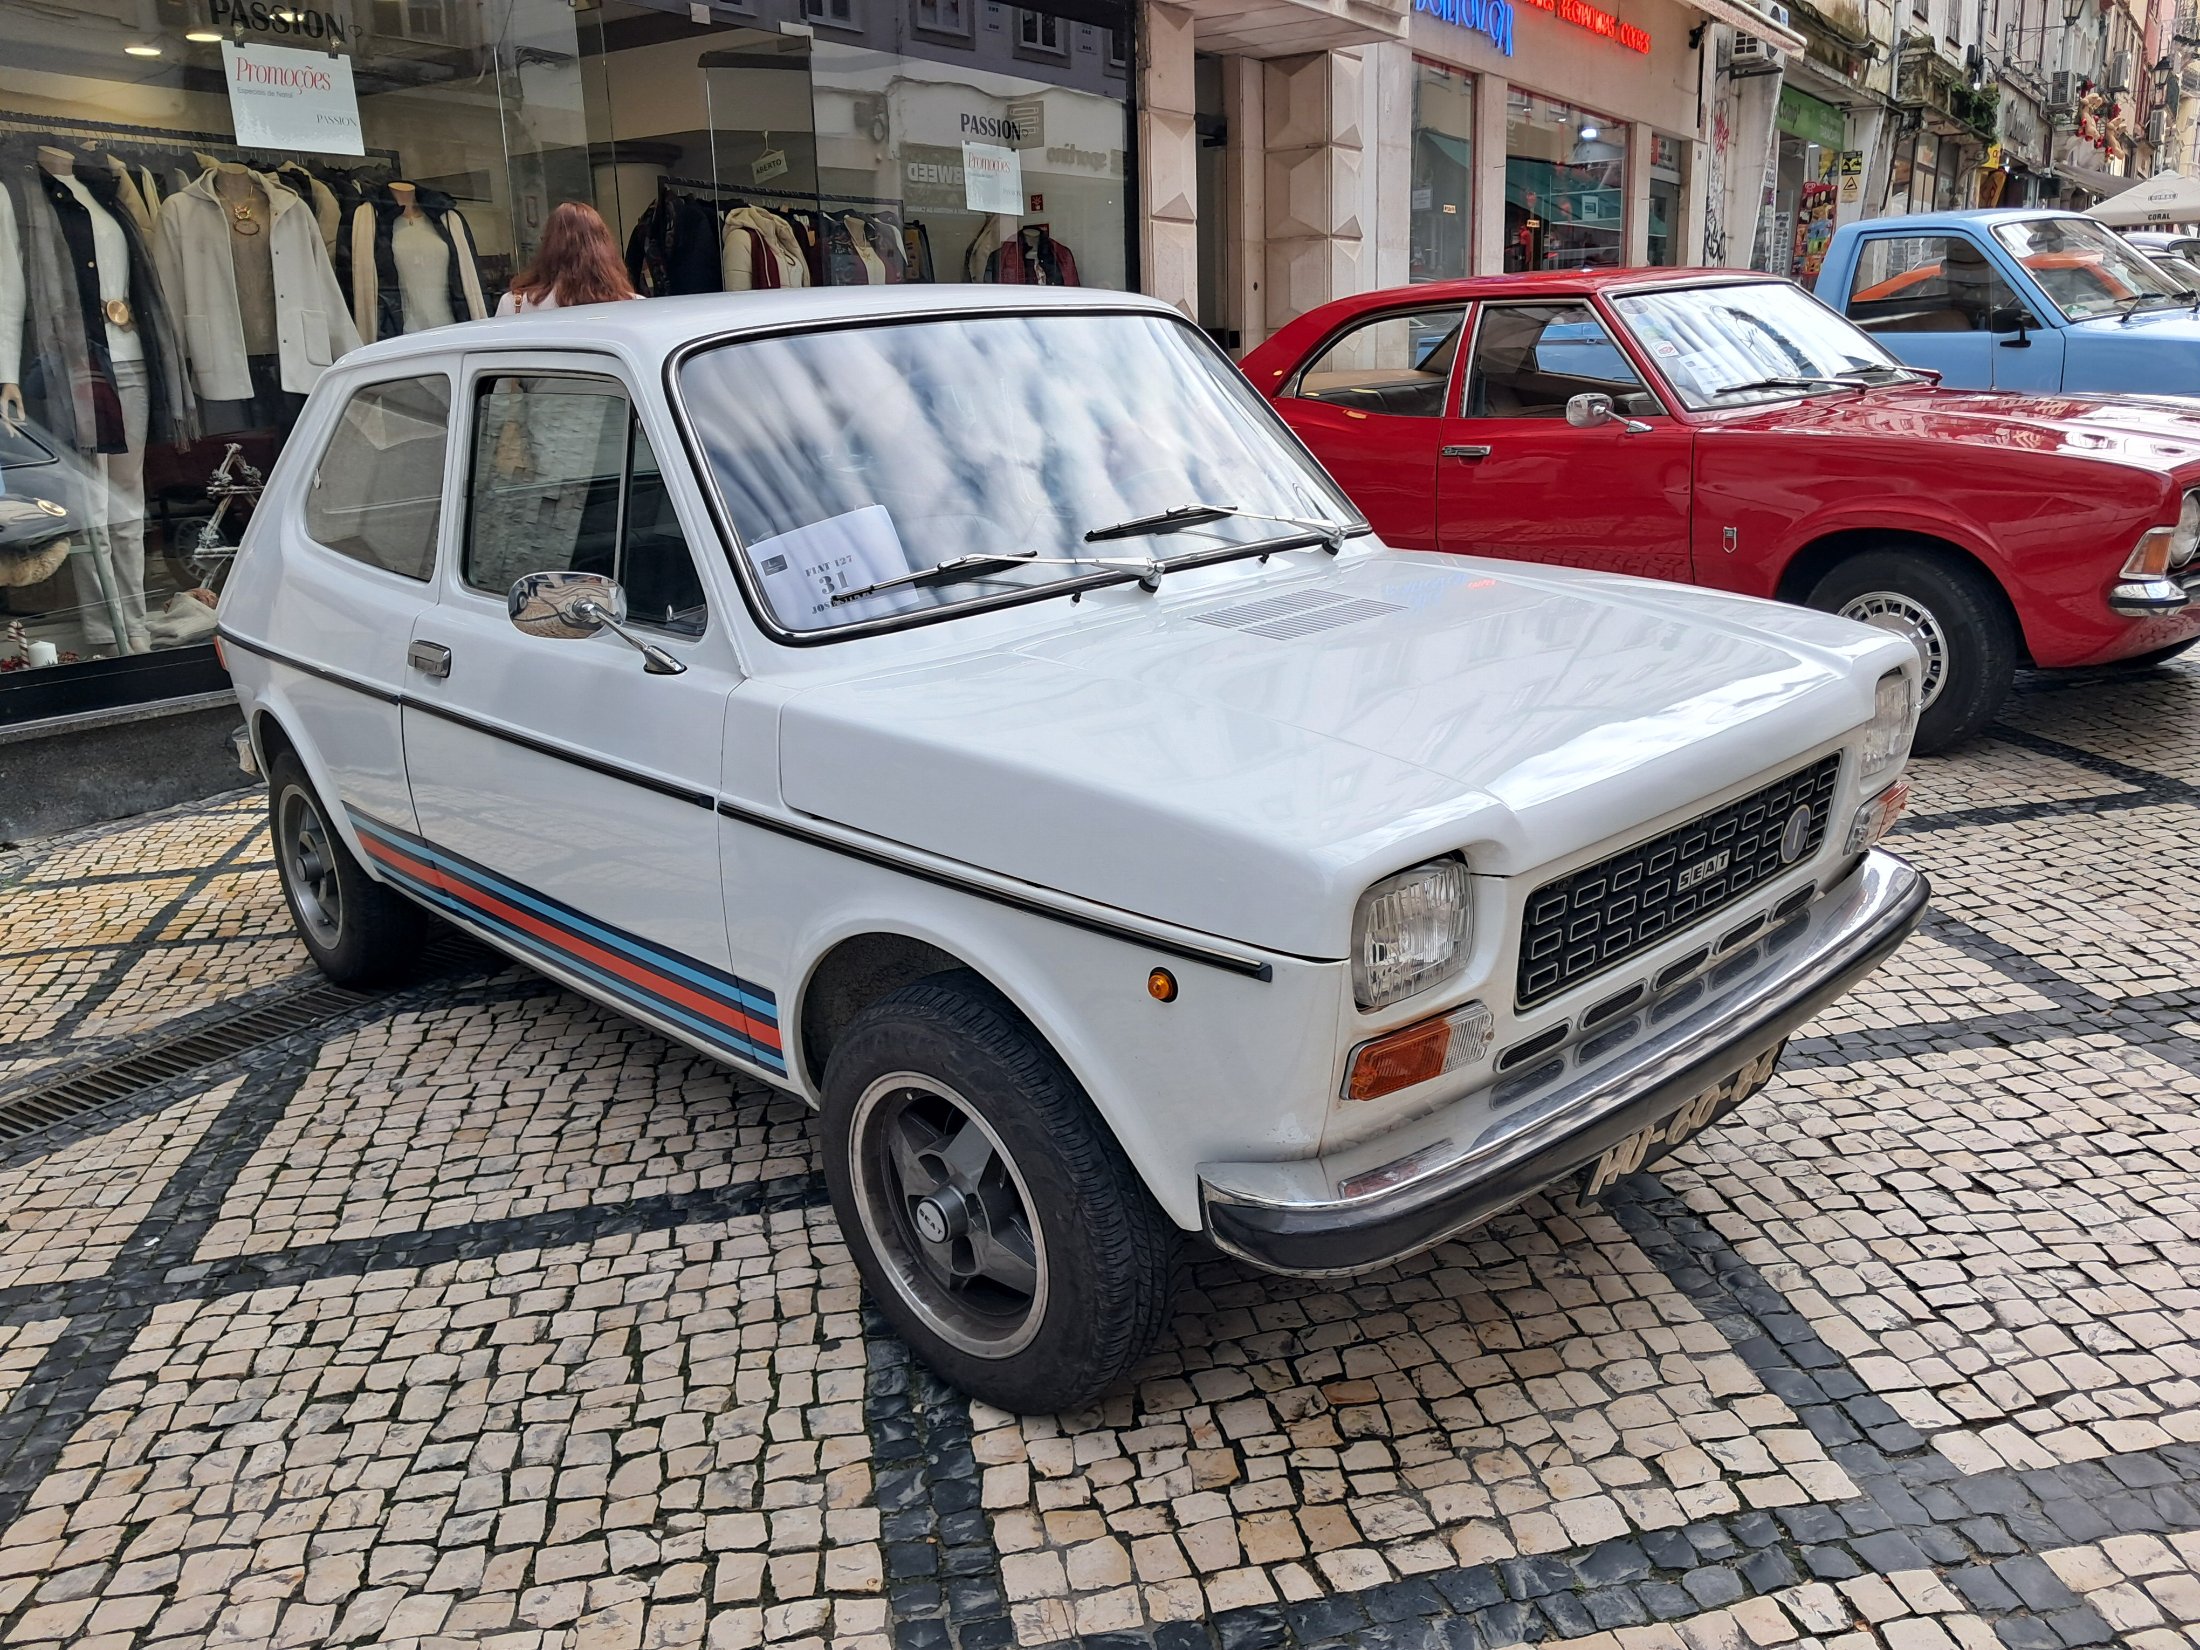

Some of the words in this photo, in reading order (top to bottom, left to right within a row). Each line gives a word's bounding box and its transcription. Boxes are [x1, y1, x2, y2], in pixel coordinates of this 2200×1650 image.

[209, 0, 347, 44] PASSION
[236, 57, 331, 95] Promoções
[317, 114, 357, 127] PASSION
[960, 113, 1021, 141] PASSION
[757, 158, 782, 174] ABERTO
[2147, 213, 2171, 221] CORAL
[805, 562, 831, 577] FIAT
[834, 555, 854, 568] 127
[819, 572, 849, 595] 31
[1677, 849, 1731, 892] SEAT
[919, 1209, 943, 1234] SEAT
